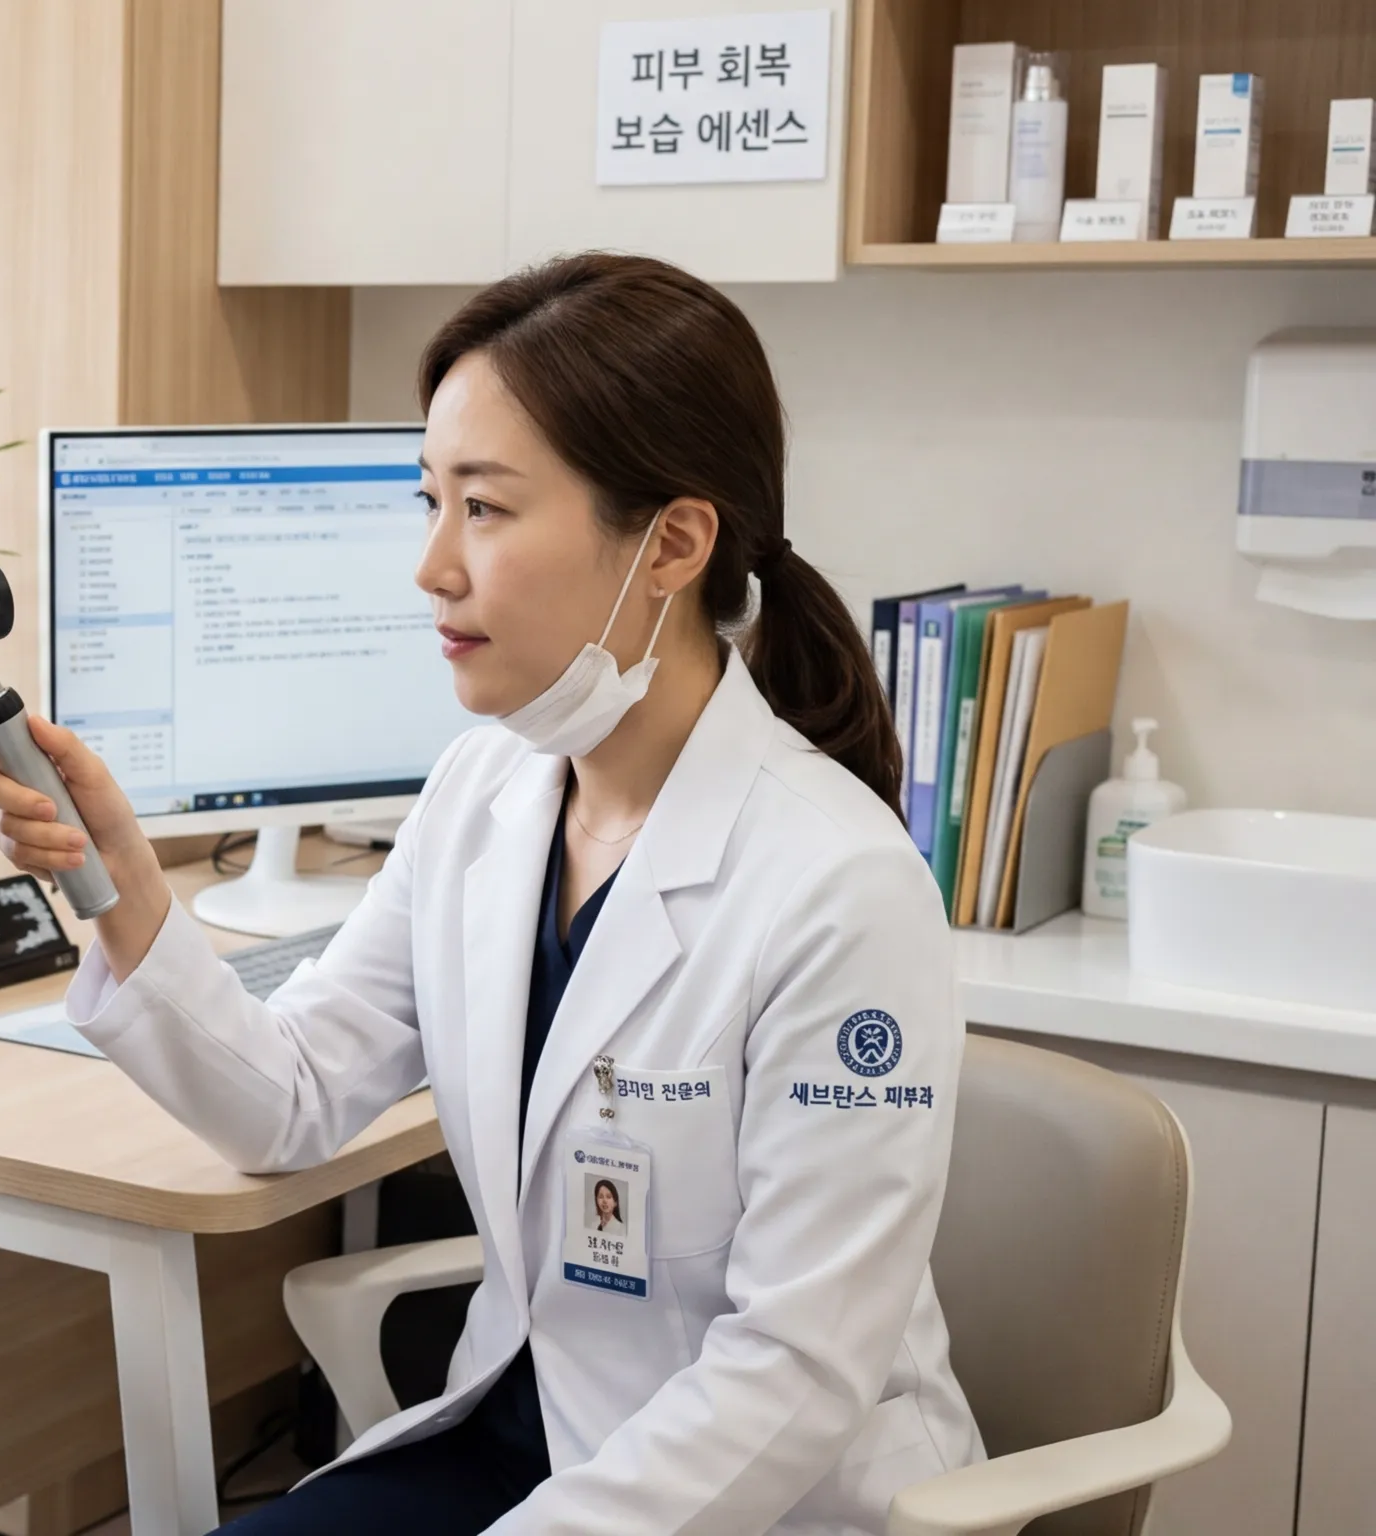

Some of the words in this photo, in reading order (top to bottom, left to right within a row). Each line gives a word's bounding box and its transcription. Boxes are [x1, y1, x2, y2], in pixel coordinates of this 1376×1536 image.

[631, 48, 704, 92] 피부
[717, 43, 792, 88] 회복
[611, 113, 684, 154] 보습
[697, 108, 809, 152] 에센스
